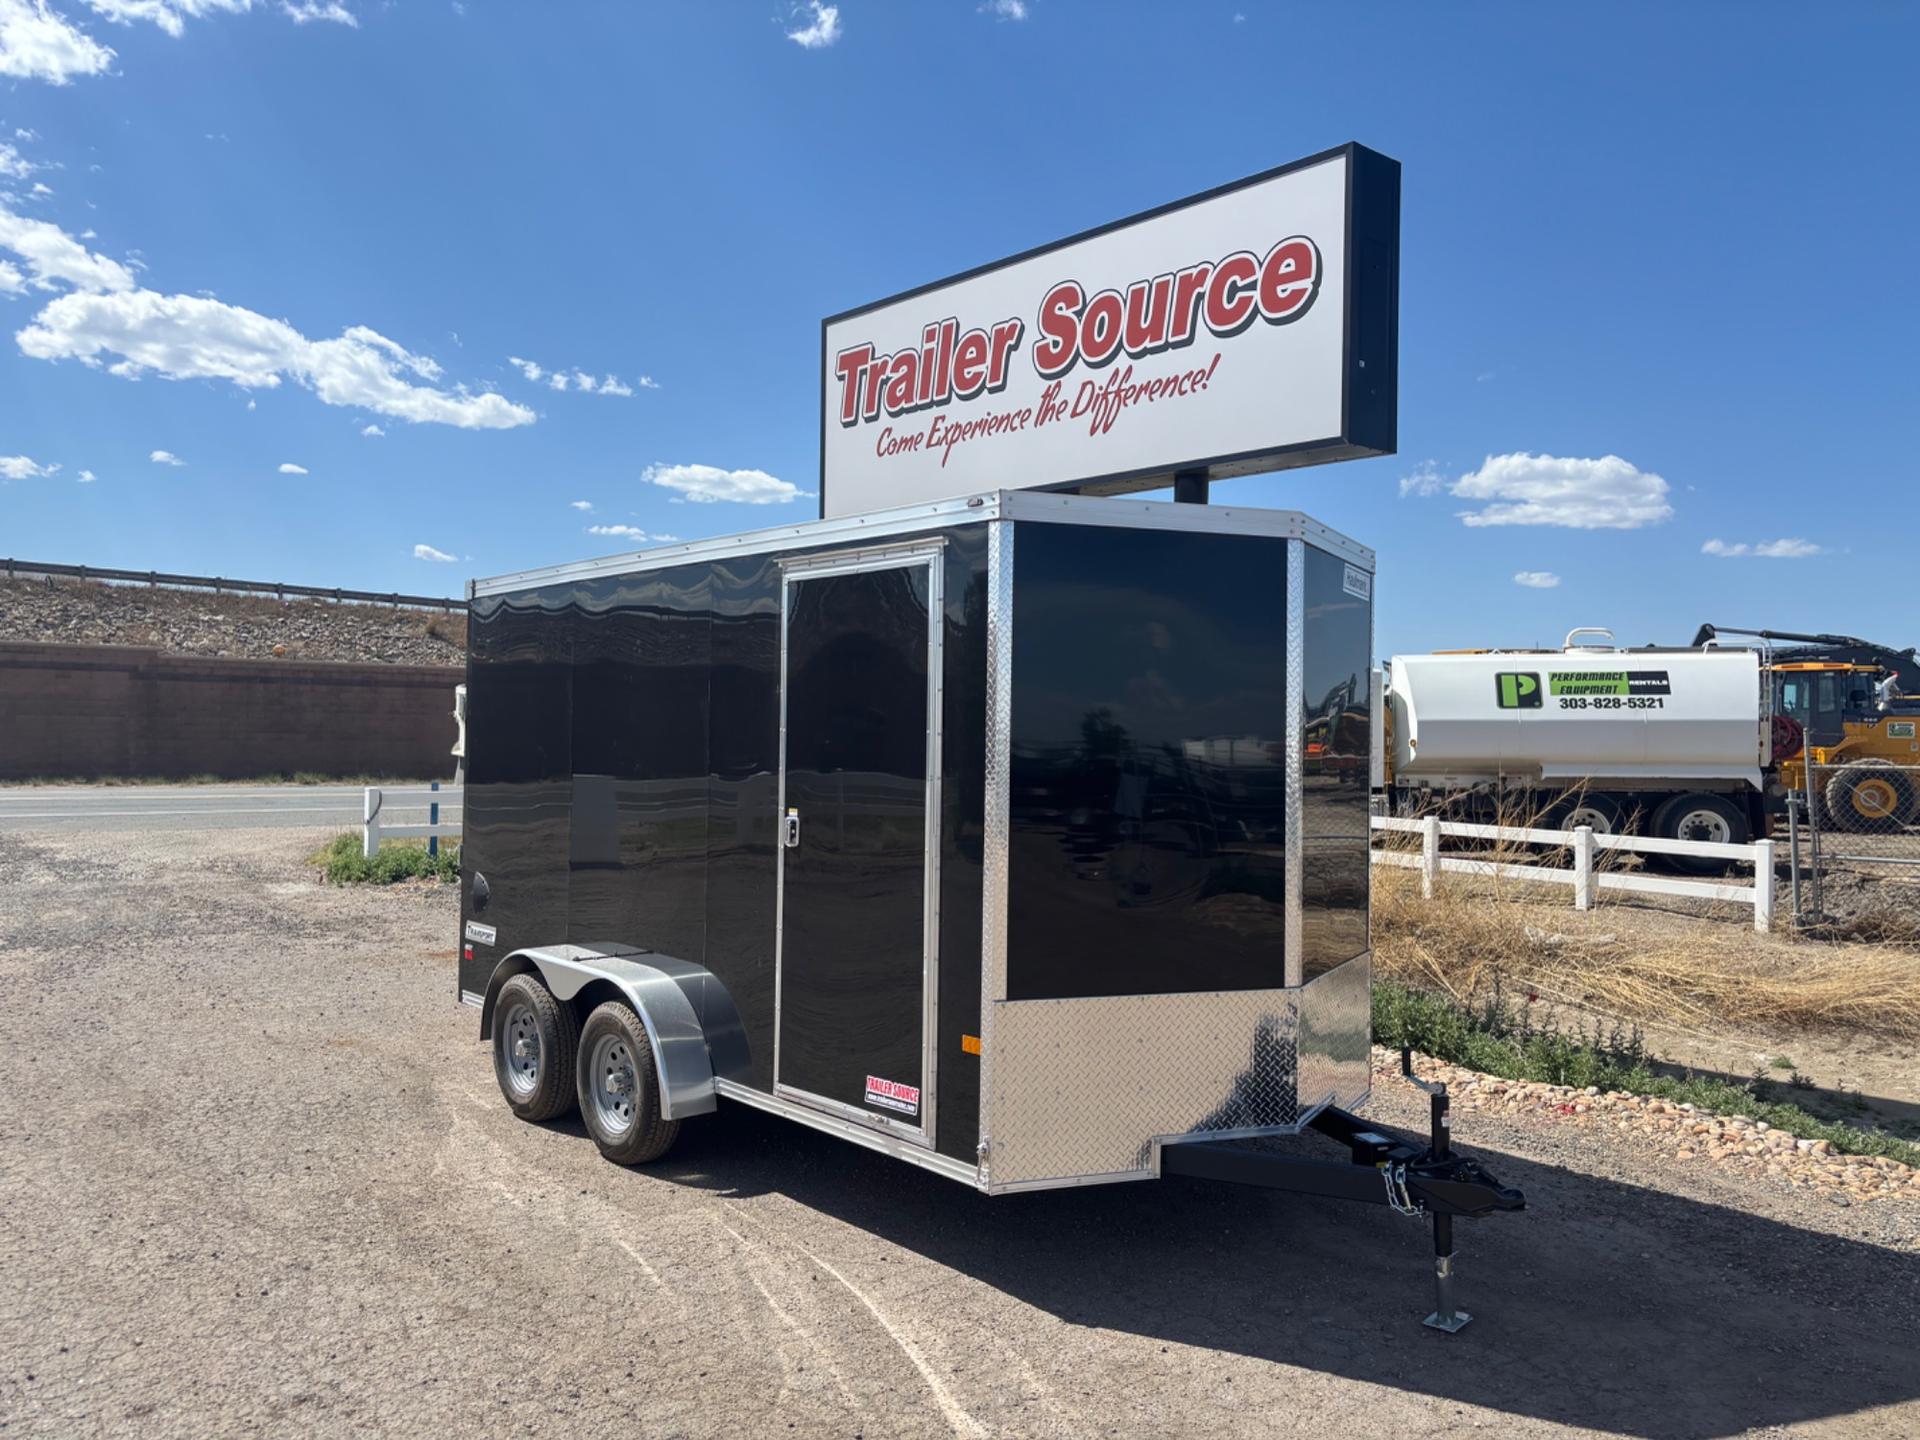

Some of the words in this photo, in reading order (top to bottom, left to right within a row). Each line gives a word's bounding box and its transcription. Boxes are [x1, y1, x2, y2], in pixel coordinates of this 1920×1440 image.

[836, 316, 1025, 428] Trailer
[1033, 235, 1323, 380] Source
[876, 427, 924, 457] Come
[926, 408, 1032, 468] Experience
[1034, 380, 1068, 427] the
[1070, 353, 1221, 436] Difference!
[1551, 671, 1625, 682] PERFORMANCE
[1501, 675, 1536, 707] P
[1560, 685, 1619, 695] EQUIPMENT
[1559, 698, 1664, 709] 303-828-5321
[867, 1077, 893, 1096] TRAILER
[893, 1083, 919, 1102] SOURCE
